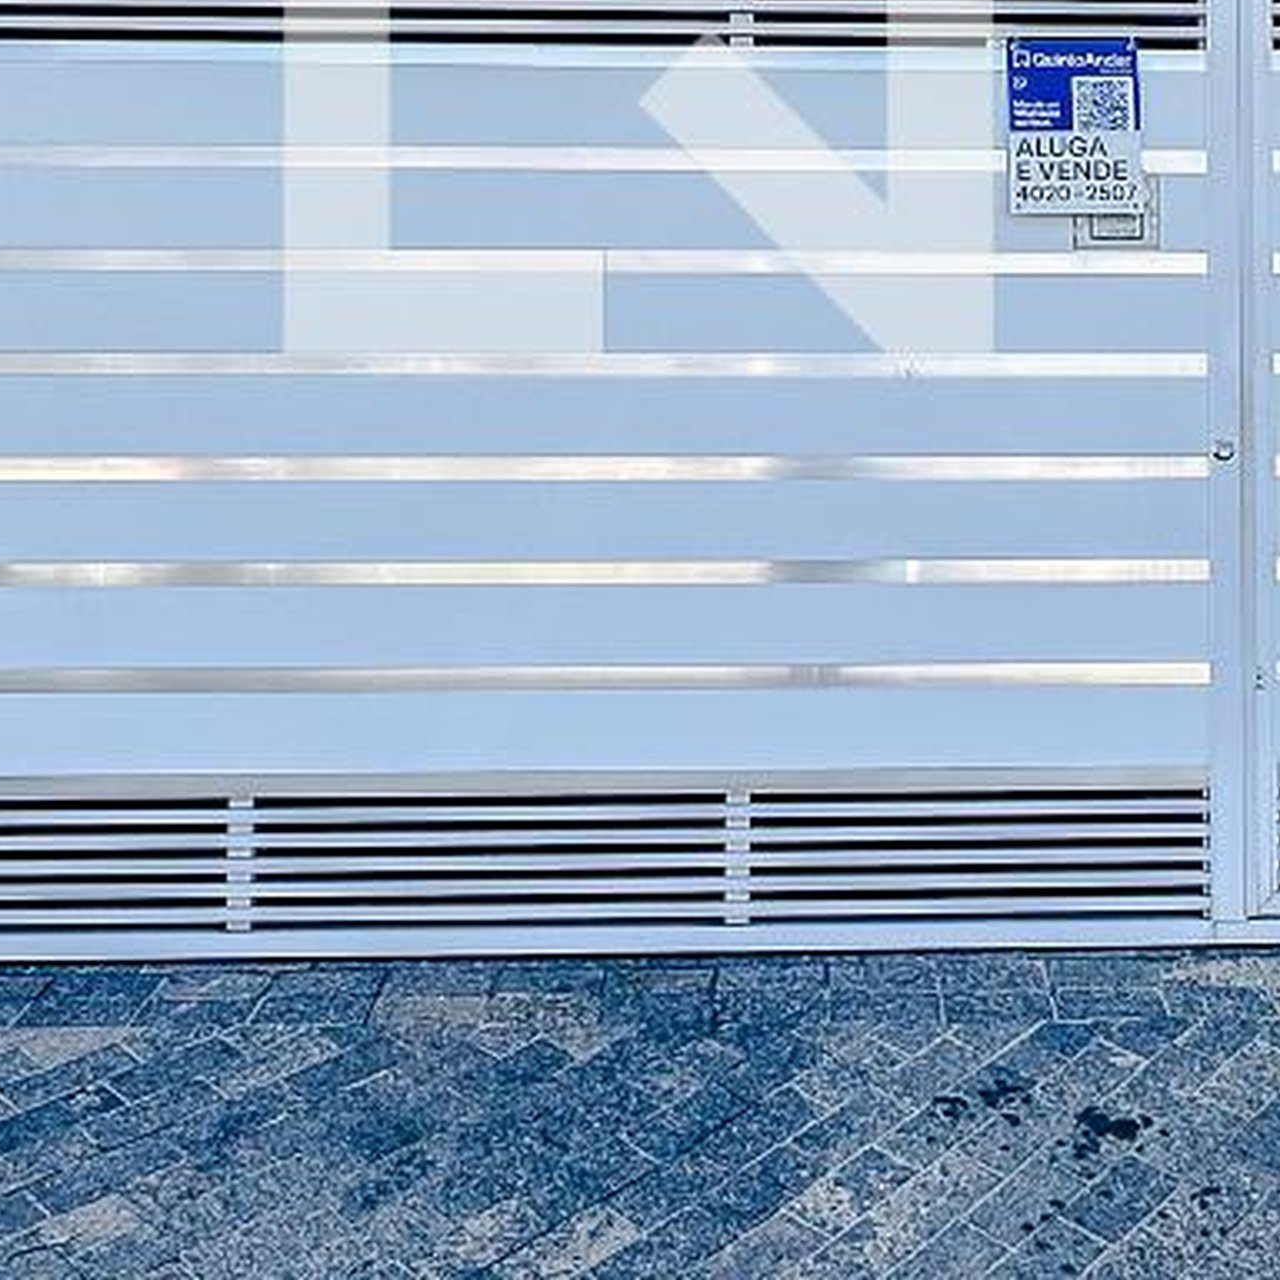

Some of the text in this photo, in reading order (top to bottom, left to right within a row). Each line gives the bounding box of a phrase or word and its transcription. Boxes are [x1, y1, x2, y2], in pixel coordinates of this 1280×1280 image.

[1016, 135, 1108, 157] ALUGA
[1016, 159, 1127, 181] E VENDE
